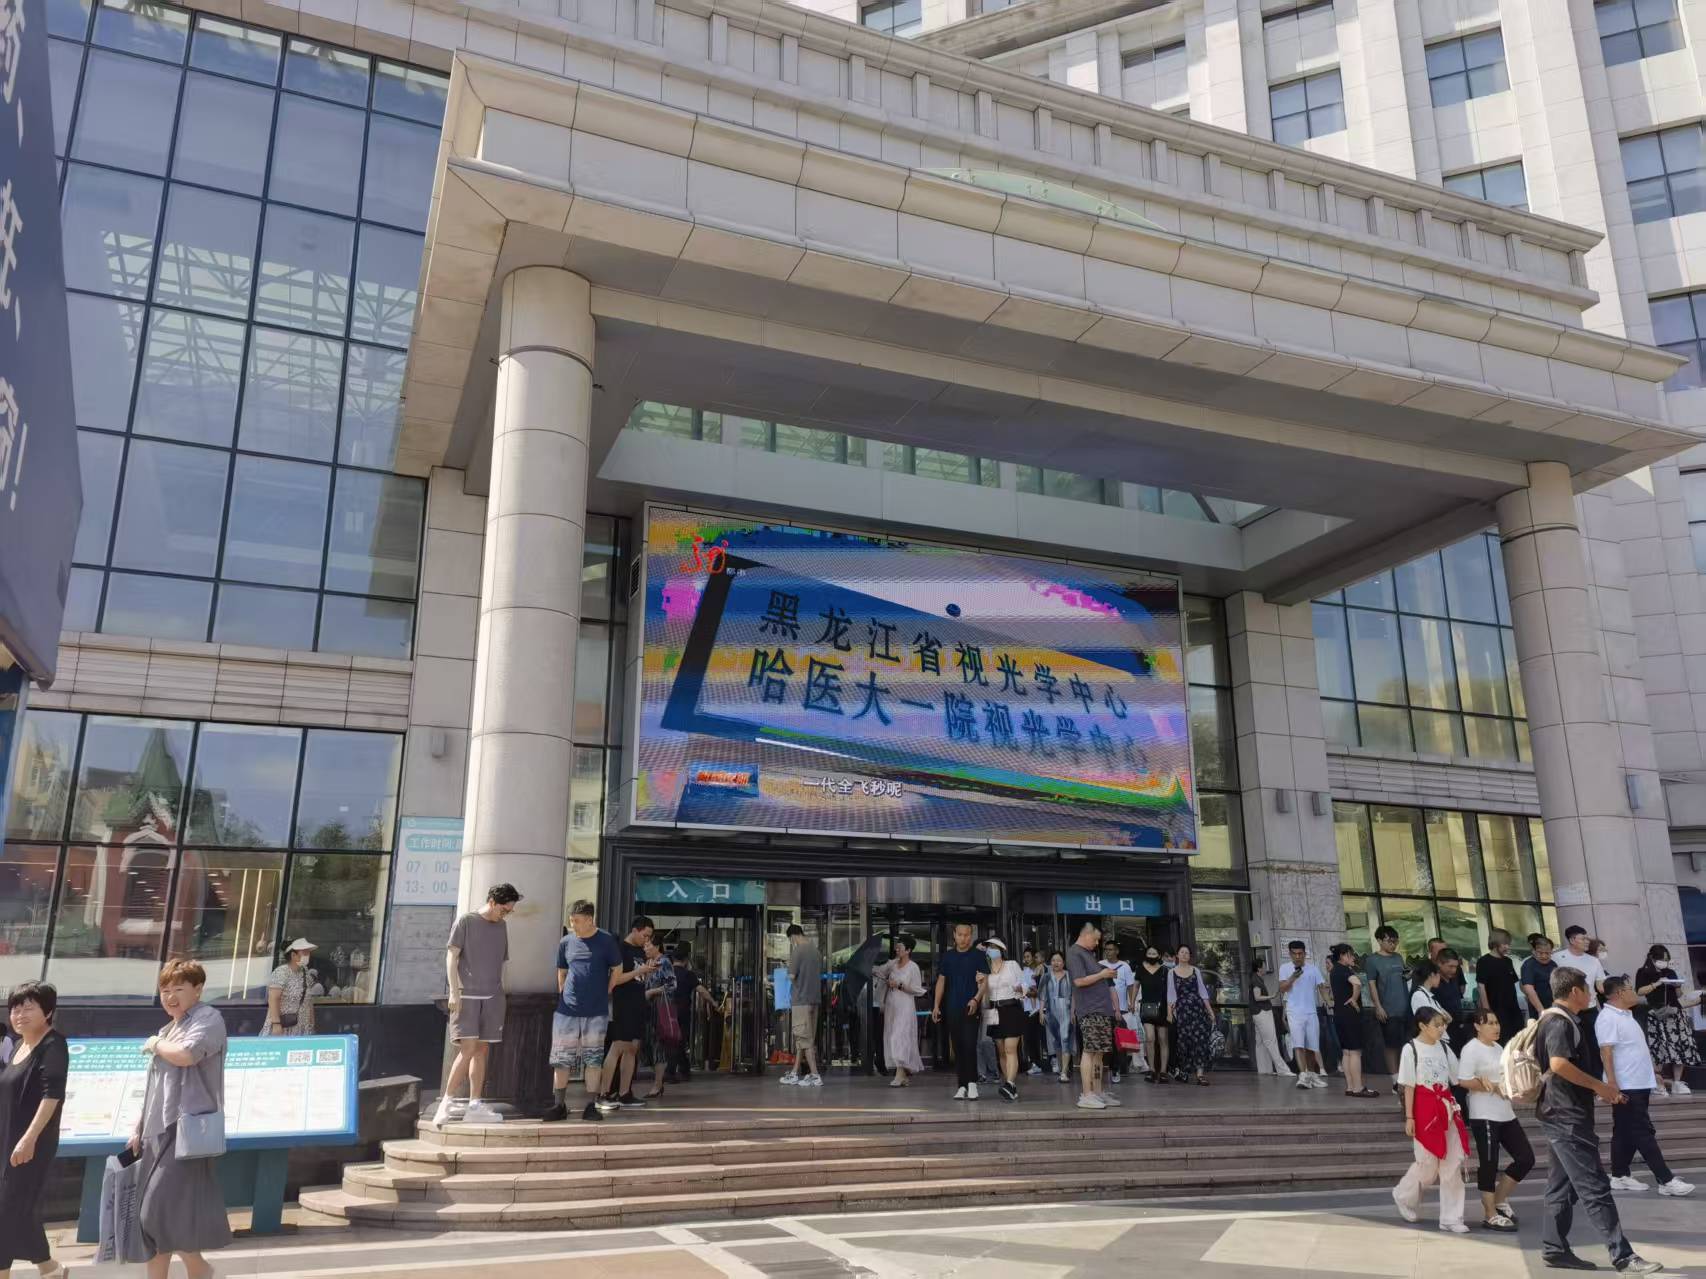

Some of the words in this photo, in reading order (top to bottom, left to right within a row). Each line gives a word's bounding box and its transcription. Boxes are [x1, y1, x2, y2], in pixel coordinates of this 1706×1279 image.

[758, 591, 1128, 719] 黑龙江省视光学中心
[747, 647, 1148, 769] 哈医大一院视光学中心
[803, 776, 902, 798] 一代全飞秒呢
[666, 880, 730, 899] 入口
[1085, 894, 1134, 912] 出口
